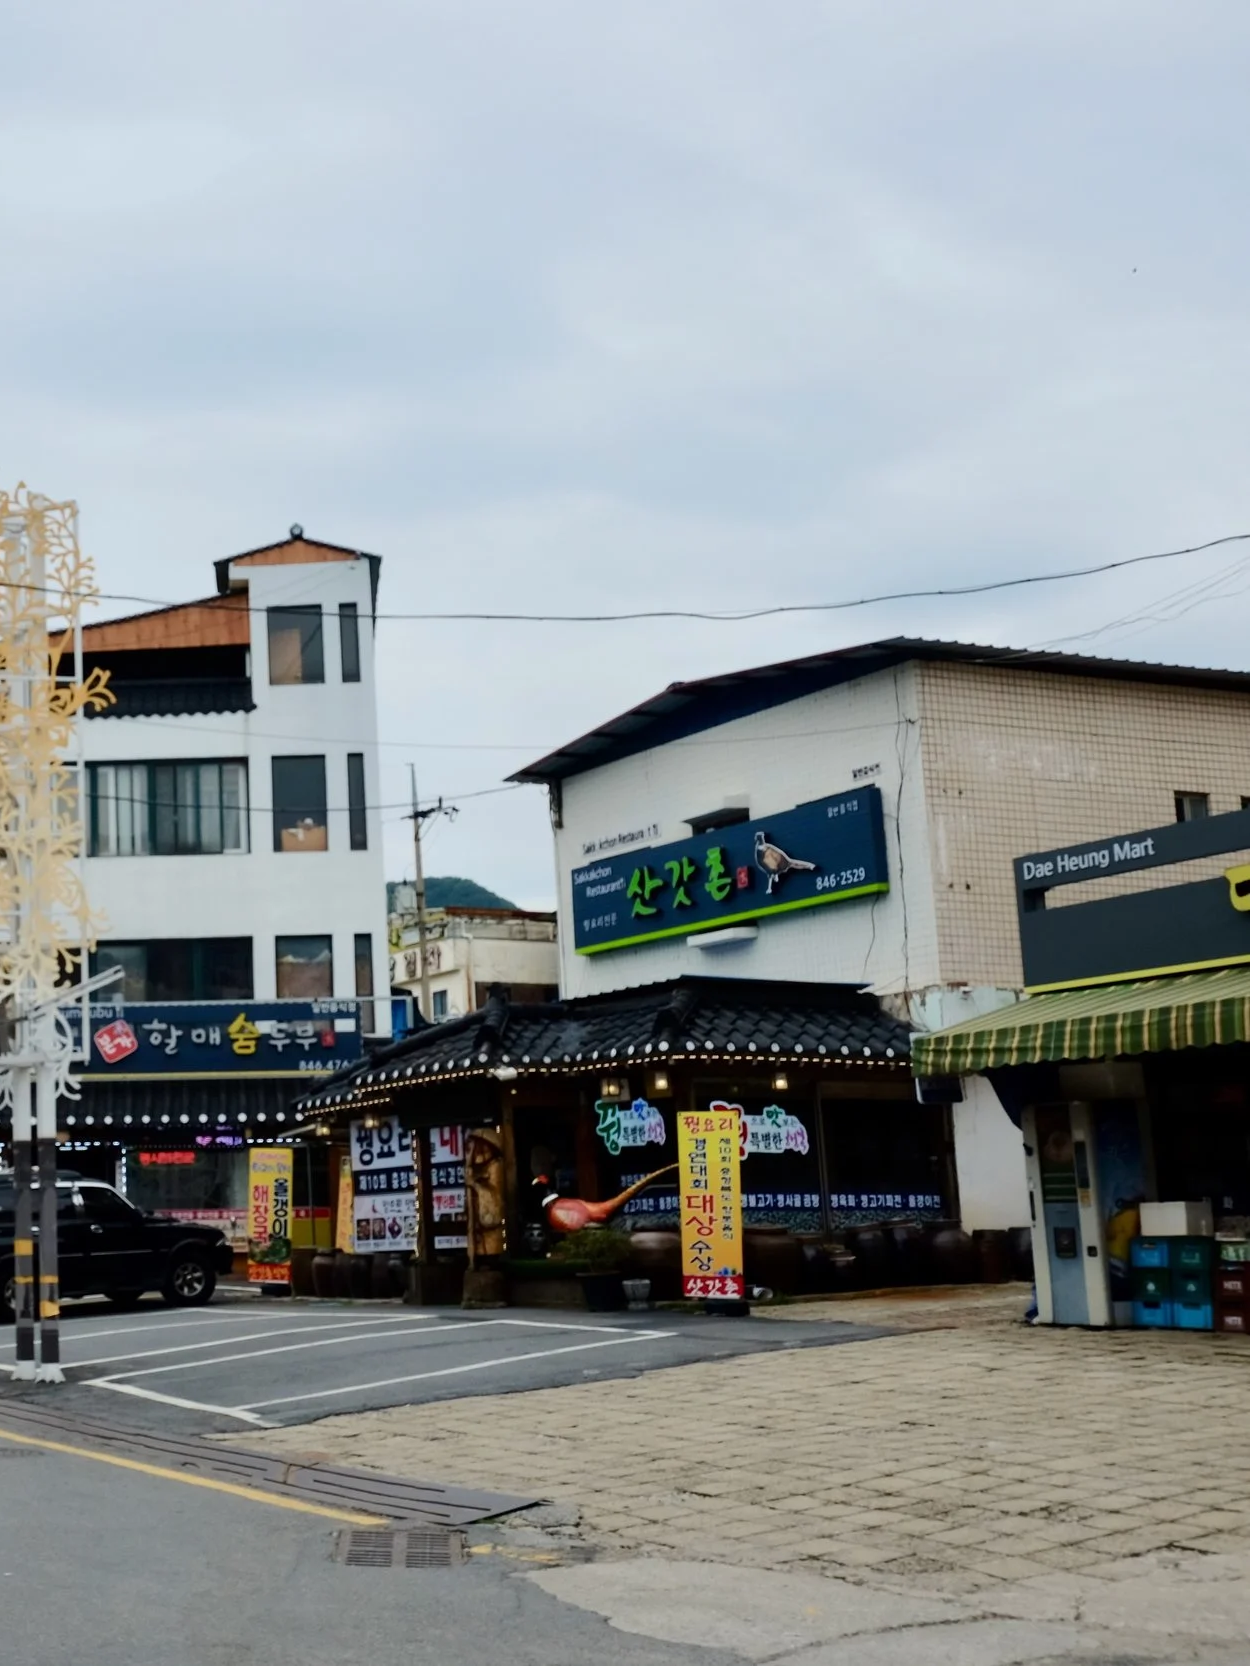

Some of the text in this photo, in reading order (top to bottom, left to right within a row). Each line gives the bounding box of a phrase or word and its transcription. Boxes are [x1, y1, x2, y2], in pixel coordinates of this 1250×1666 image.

[618, 827, 651, 844] Restaurat
[1023, 837, 1155, 881] Dae Heung Mart
[299, 1059, 352, 1070] 846.476
[683, 1115, 733, 1134] 꿩요리
[750, 1131, 783, 1150] 특별한
[359, 1173, 388, 1190] 제10회
[252, 1184, 270, 1246] 해장국
[685, 1194, 718, 1237] 대상
[689, 1240, 715, 1272] 수상
